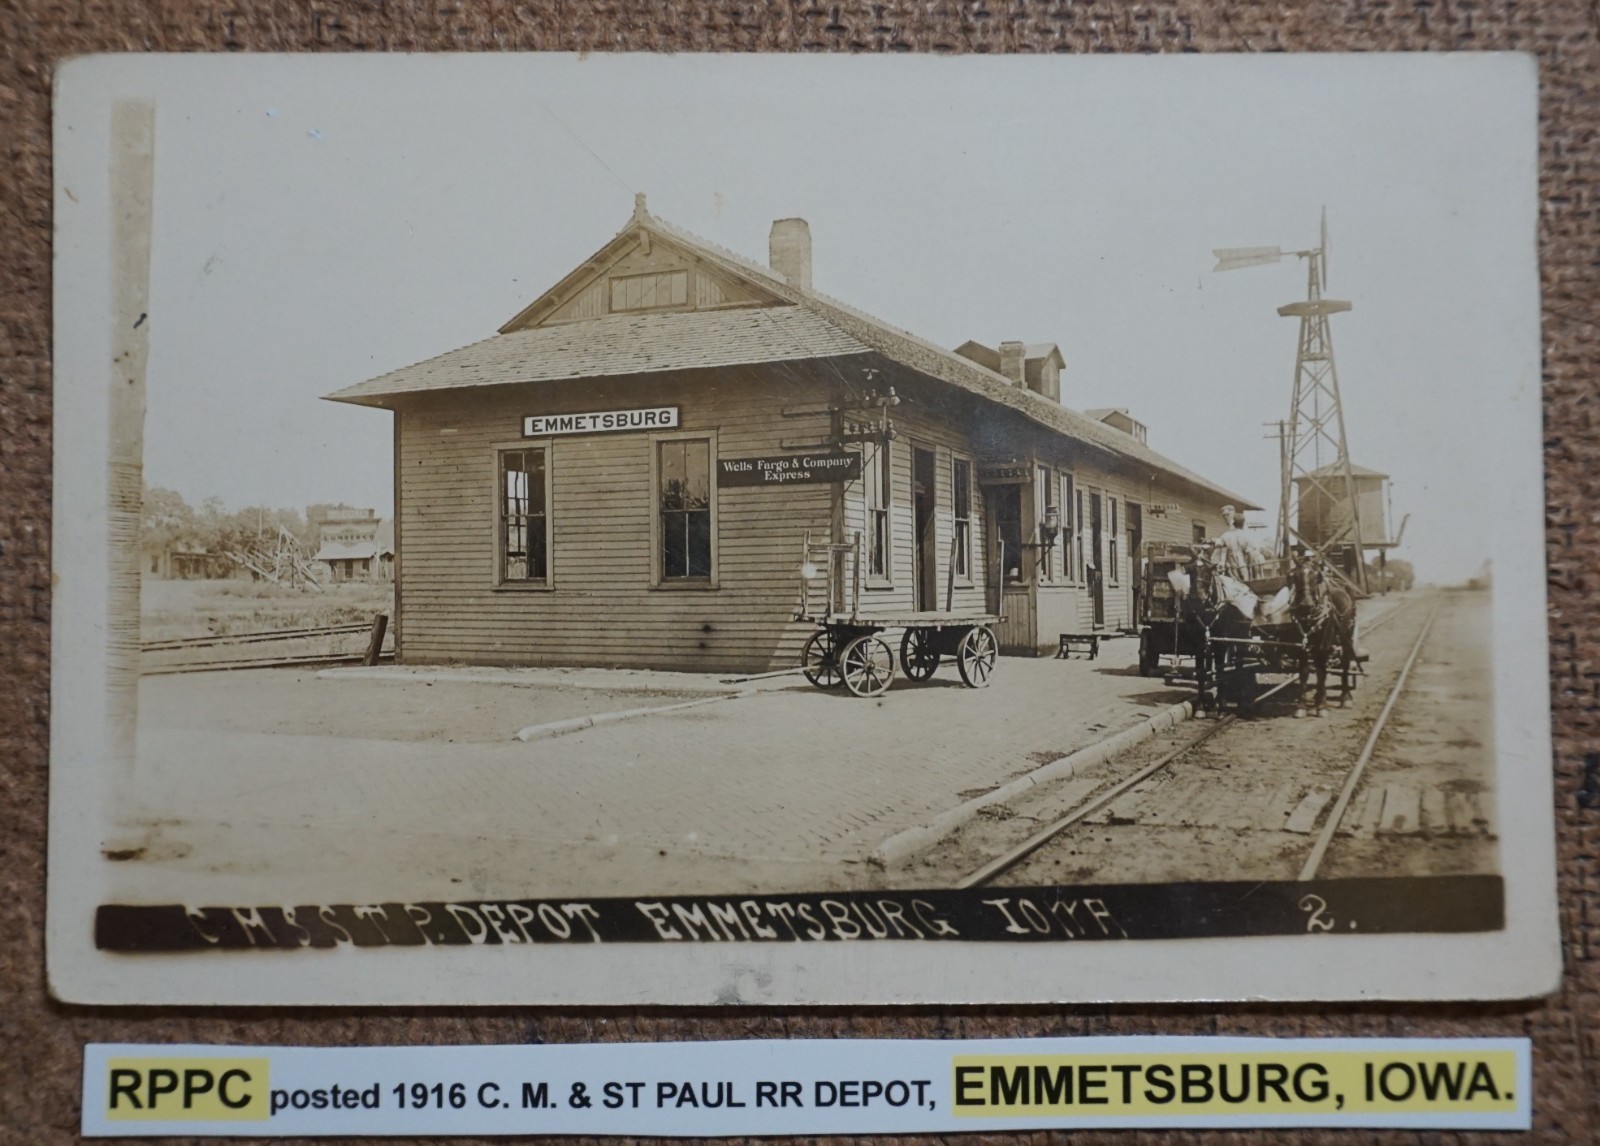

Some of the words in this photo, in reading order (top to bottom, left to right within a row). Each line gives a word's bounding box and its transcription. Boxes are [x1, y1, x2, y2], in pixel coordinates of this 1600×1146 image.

[532, 410, 672, 433] EMMETSBURG
[723, 461, 753, 472] Wells
[757, 459, 789, 473] Fargo
[791, 457, 799, 468] &
[802, 456, 853, 469] Company
[764, 470, 811, 482] Express
[445, 903, 602, 946] DEPOT
[634, 899, 960, 941] EMMETSBURG
[981, 898, 1128, 938] IOWA
[108, 1068, 253, 1110] RPPC
[270, 1083, 380, 1116] posted
[391, 1083, 467, 1109] 1916
[476, 1082, 509, 1109] C.
[521, 1082, 558, 1109] M.
[568, 1082, 592, 1109] &
[602, 1082, 646, 1109] ST
[657, 1081, 746, 1108] PAUL
[755, 1081, 803, 1108] RR
[814, 1080, 936, 1111] DEPOT,
[954, 1062, 1345, 1110] EMMETSBURG,
[1363, 1061, 1515, 1101] IOWA.
